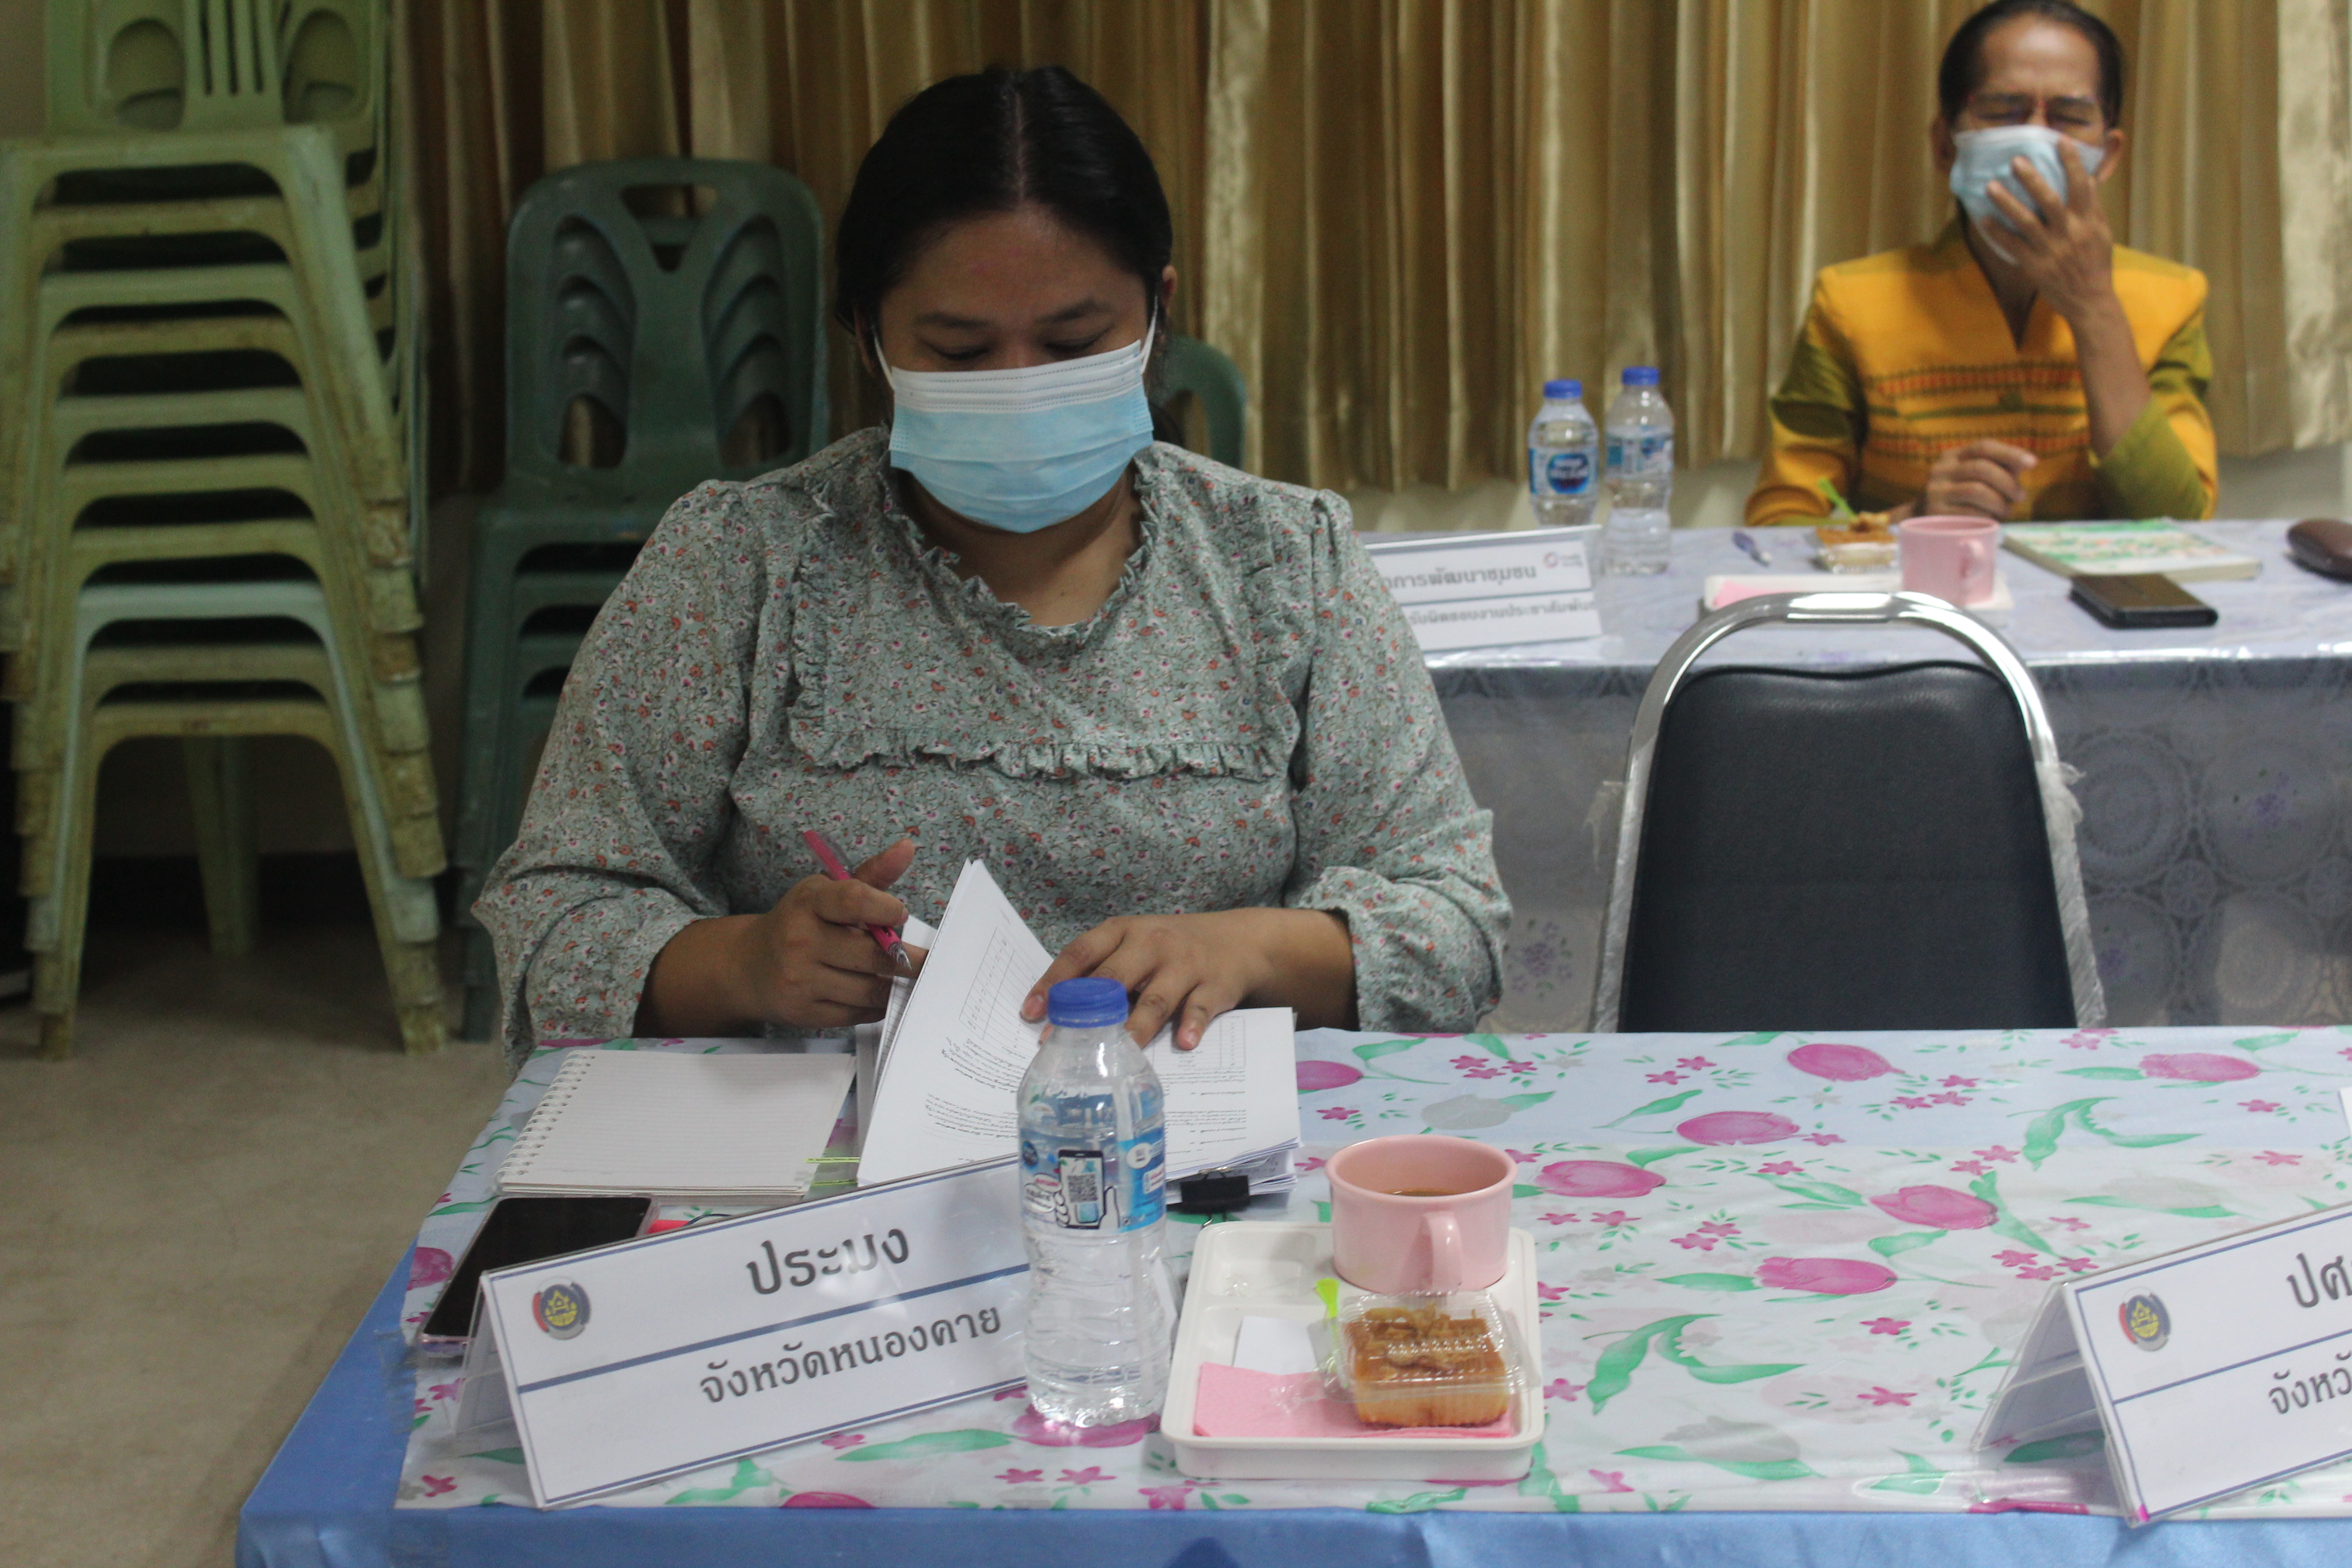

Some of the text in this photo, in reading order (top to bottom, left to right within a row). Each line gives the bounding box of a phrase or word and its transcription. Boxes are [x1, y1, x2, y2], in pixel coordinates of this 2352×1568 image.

[746, 1229, 909, 1294] ประมง
[2287, 1252, 2352, 1308] ปศ
[699, 1307, 1001, 1403] จังหวัดหนองคาย
